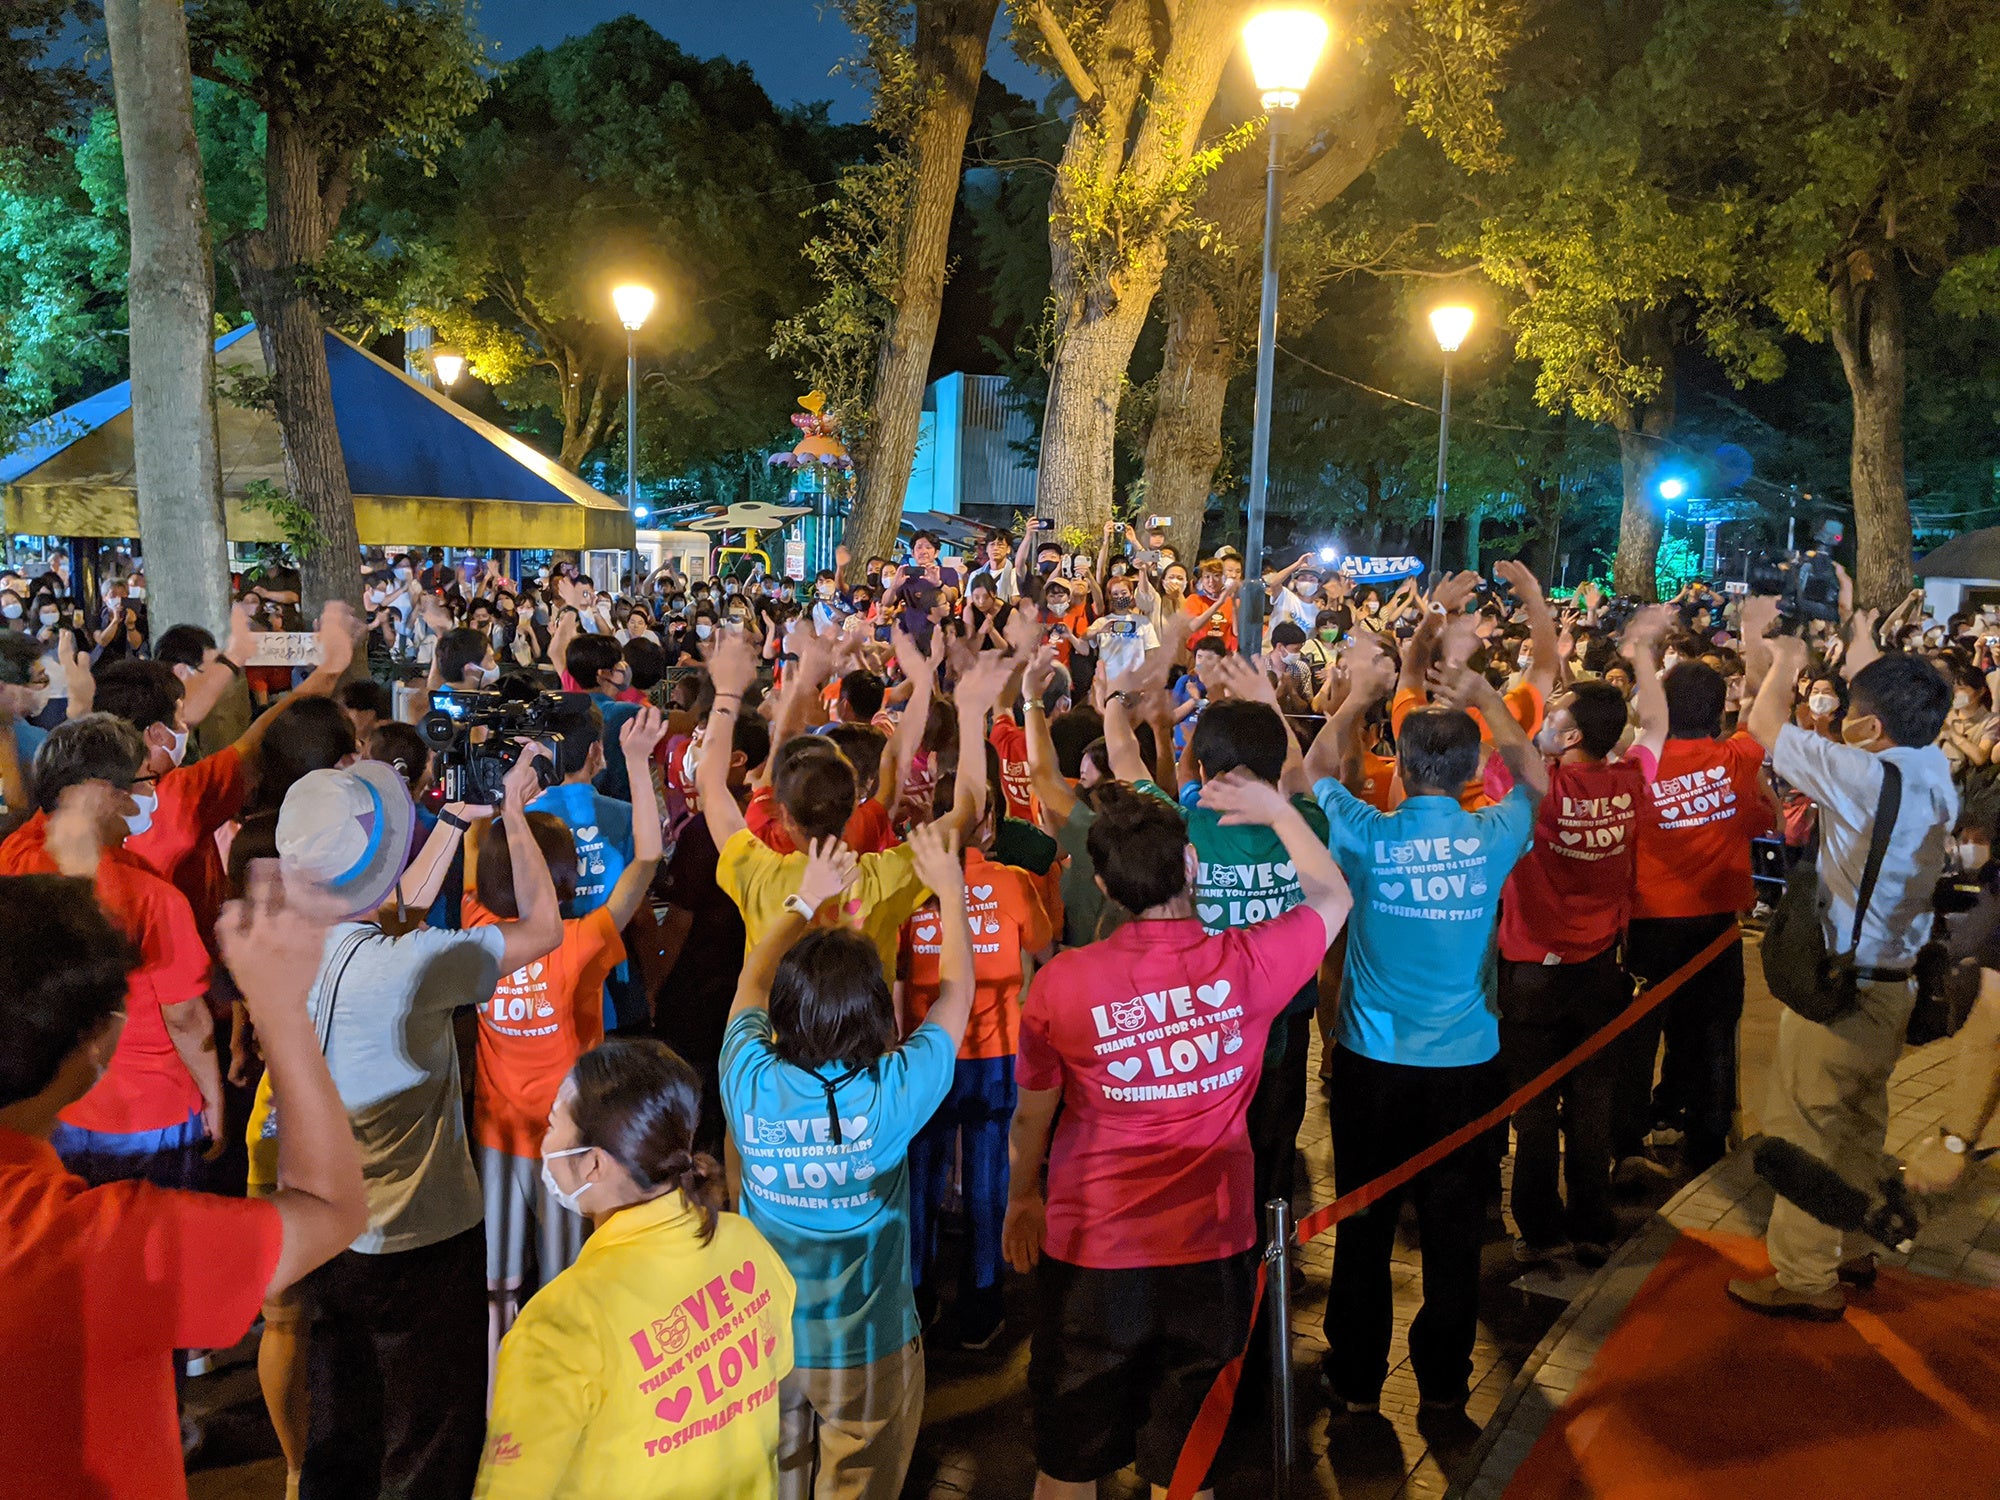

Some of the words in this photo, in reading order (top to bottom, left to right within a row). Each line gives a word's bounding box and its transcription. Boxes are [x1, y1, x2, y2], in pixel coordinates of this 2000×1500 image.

[1405, 865, 1426, 875] YOU
[1426, 863, 1445, 872] FOR
[1446, 861, 1458, 871] 94
[1458, 856, 1487, 868] YEARS
[1225, 888, 1245, 897] YOU
[1372, 900, 1446, 920] TOSHIMAEN
[1449, 907, 1484, 920] STAFF
[1094, 1035, 1136, 1056] THANK
[1137, 1028, 1164, 1044] YOU
[1164, 1022, 1190, 1037] FOR
[1190, 1016, 1205, 1029] 94
[1205, 1005, 1244, 1024] YEARS
[1102, 1080, 1198, 1102] TOSHIMAEN
[1200, 1066, 1244, 1093] STAFF
[742, 1144, 774, 1158] THANK
[777, 1146, 801, 1158] YOU
[801, 1145, 824, 1157] FOR
[826, 1145, 838, 1155] 94
[840, 1138, 873, 1154] YEARS
[748, 1179, 828, 1209] TOSHIMAEN
[831, 1189, 876, 1209] STAFF
[638, 1363, 686, 1395] THANK
[685, 1341, 711, 1364] YOU
[710, 1322, 733, 1347] FOR
[731, 1312, 744, 1329] 94
[743, 1289, 771, 1319] YEARS
[644, 1399, 744, 1457] TOSHIMAEN
